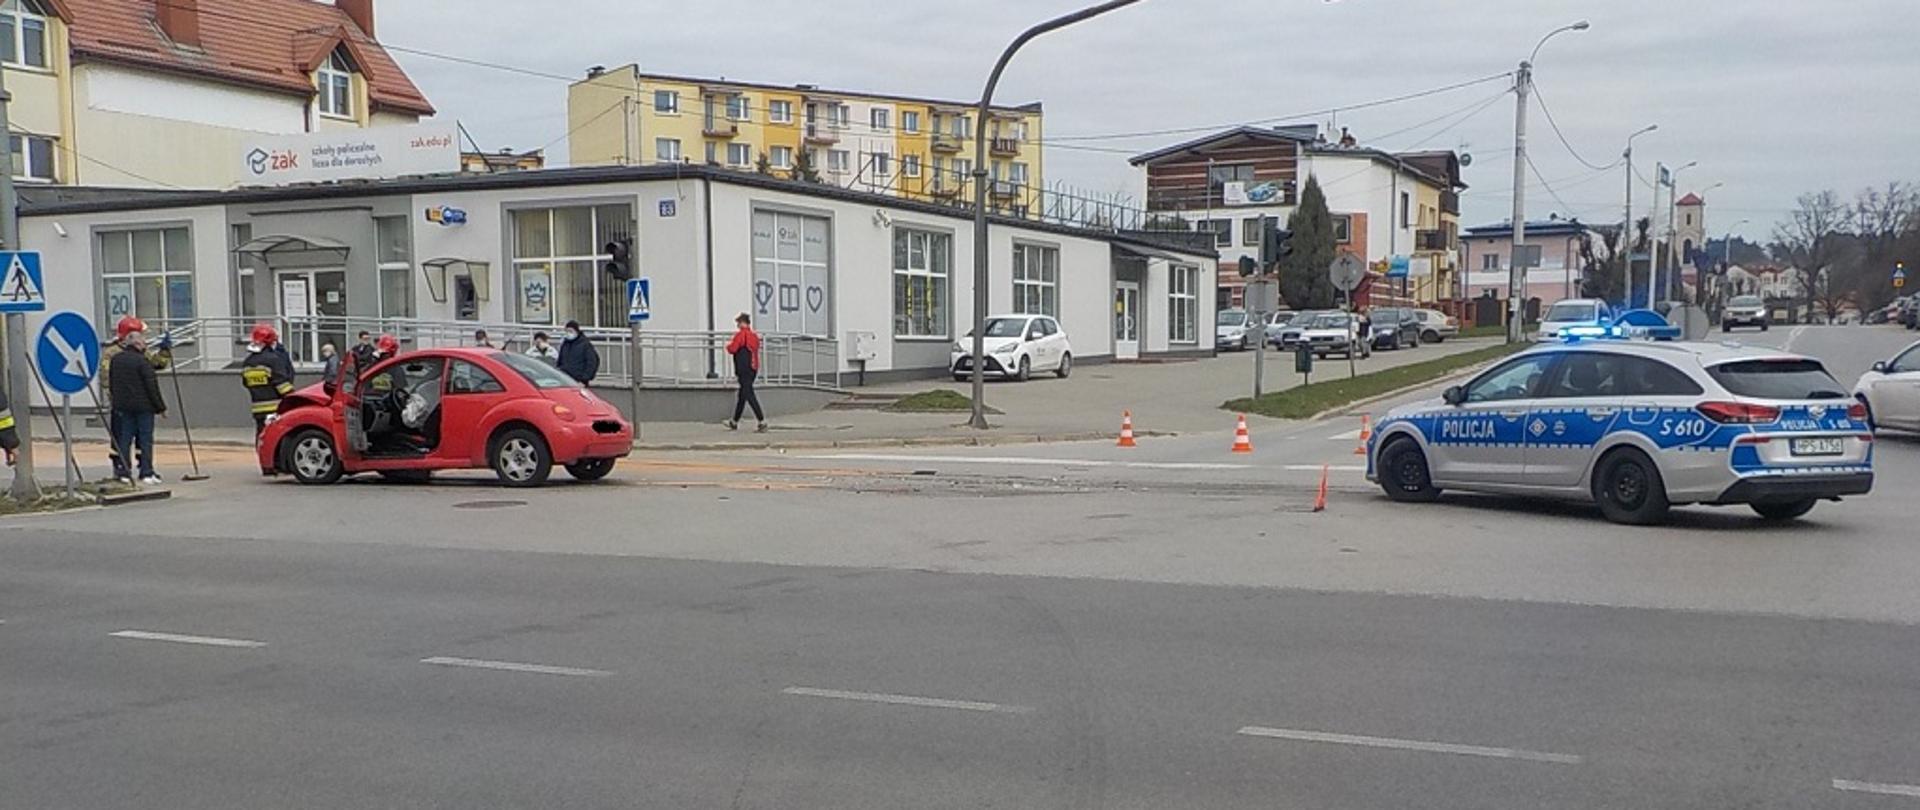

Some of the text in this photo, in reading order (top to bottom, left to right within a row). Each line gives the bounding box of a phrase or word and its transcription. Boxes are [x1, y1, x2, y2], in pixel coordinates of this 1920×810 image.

[271, 150, 298, 171] żak
[111, 295, 129, 315] 20
[1442, 420, 1496, 438] POLICJA
[1659, 419, 1705, 436] S 610
